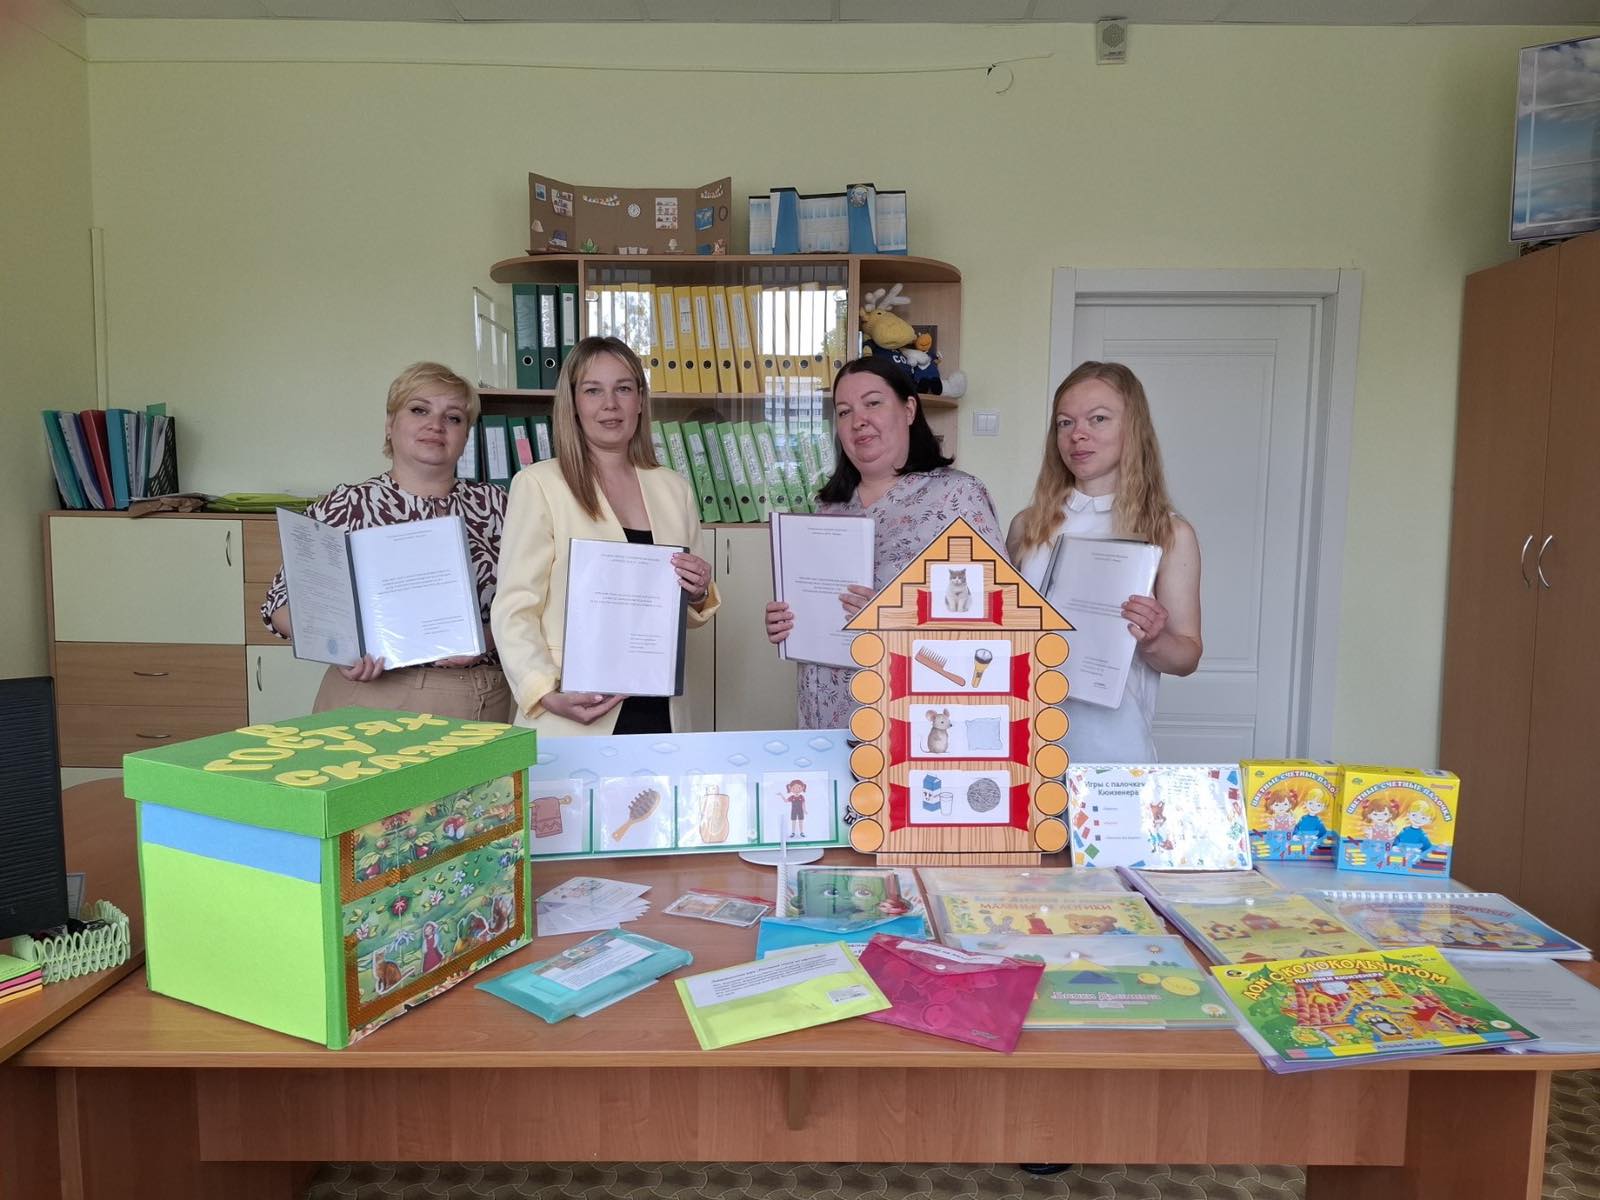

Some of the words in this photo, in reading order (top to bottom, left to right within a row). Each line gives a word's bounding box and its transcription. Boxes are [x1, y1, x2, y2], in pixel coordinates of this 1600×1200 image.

[202, 713, 449, 772] ГОСТЯХ
[236, 723, 302, 739] В
[274, 722, 513, 787] СКАЗКИ
[1085, 780, 1104, 790] Игры
[1251, 776, 1279, 807] ЦВЕТНЫЕ
[1280, 770, 1317, 780] СЧЕТНЫЕ
[1346, 784, 1380, 815] ЦВЕТНЫЕ
[1380, 781, 1421, 790] СЧЕТНЫЕ
[1422, 787, 1453, 822] ПАЛОЧКИ
[1242, 976, 1273, 1001] ДОМ
[1269, 972, 1284, 981] С
[1280, 958, 1448, 985] КОЛОКОЛЬЧИКОМ
[1334, 972, 1384, 981] КЮИЗЕНЕРА
